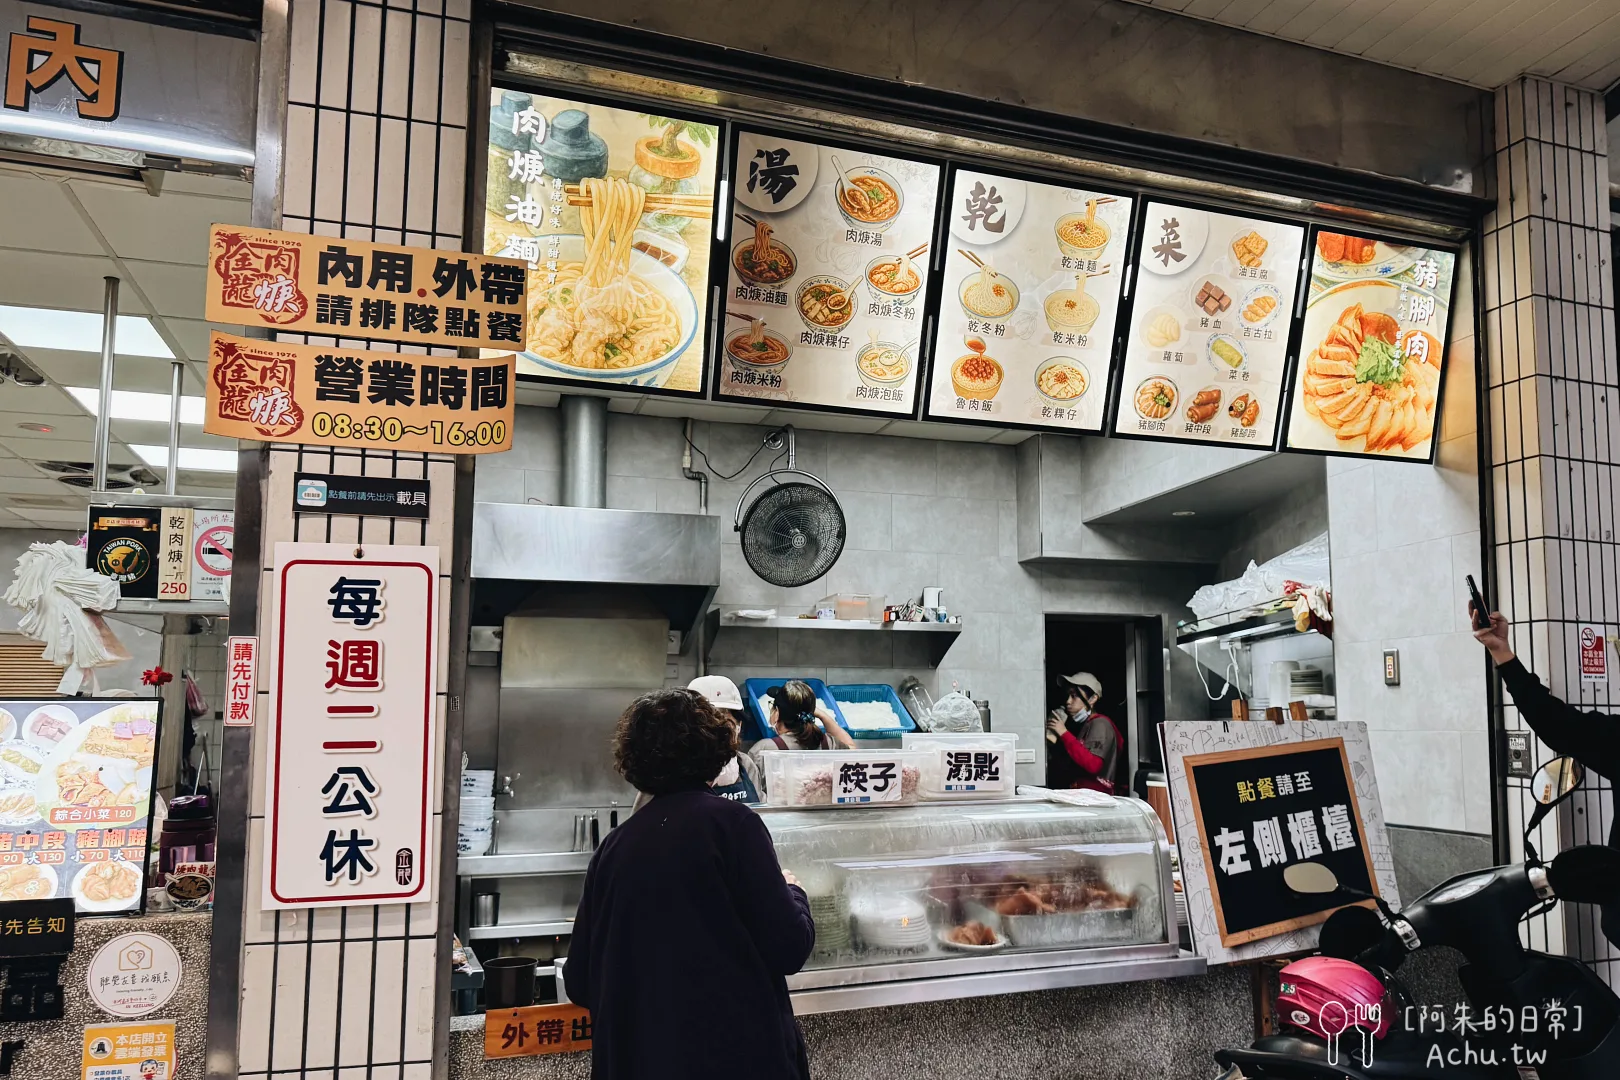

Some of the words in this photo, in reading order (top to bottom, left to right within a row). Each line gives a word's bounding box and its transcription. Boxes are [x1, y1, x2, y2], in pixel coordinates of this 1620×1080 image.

[4, 16, 124, 121] 內
[746, 147, 800, 204] 湯
[961, 180, 1006, 234] 乾
[255, 236, 278, 245] since
[845, 228, 883, 247] 肉焿湯
[1151, 217, 1187, 267] 菜
[1061, 256, 1098, 273] 乾油麵
[735, 285, 788, 305] 肉焿油麵
[315, 293, 523, 344] 請排隊點餐
[868, 302, 916, 321] 肉焿冬粉
[967, 320, 1006, 337] 乾冬粉
[1053, 331, 1088, 347] 乾米粉
[250, 348, 273, 356] since
[314, 354, 509, 411] 營業時間
[730, 370, 782, 388] 肉焿米粉
[855, 385, 904, 402] 肉焿泡飯
[955, 398, 993, 412] 魯肉飯
[1041, 406, 1077, 420] 乾粿仔
[103, 540, 125, 554] TAIWAN
[126, 540, 143, 552] PORK
[167, 516, 185, 563] 乾肉焿
[160, 582, 187, 594] 250
[229, 643, 254, 721] 請先付款
[318, 576, 384, 884] 每週二公休
[946, 751, 1000, 782] 湯匙
[838, 762, 897, 794] 筷子
[1236, 770, 1314, 804] 點餐請至
[55, 808, 111, 821] 綜合小菜
[114, 809, 132, 818] 120
[1213, 803, 1356, 876] 左側櫃檯
[3, 854, 18, 863] 90
[43, 852, 61, 861] 130
[90, 851, 104, 860] 70
[0, 917, 66, 935] 先告知
[115, 1031, 168, 1046] 本店開立
